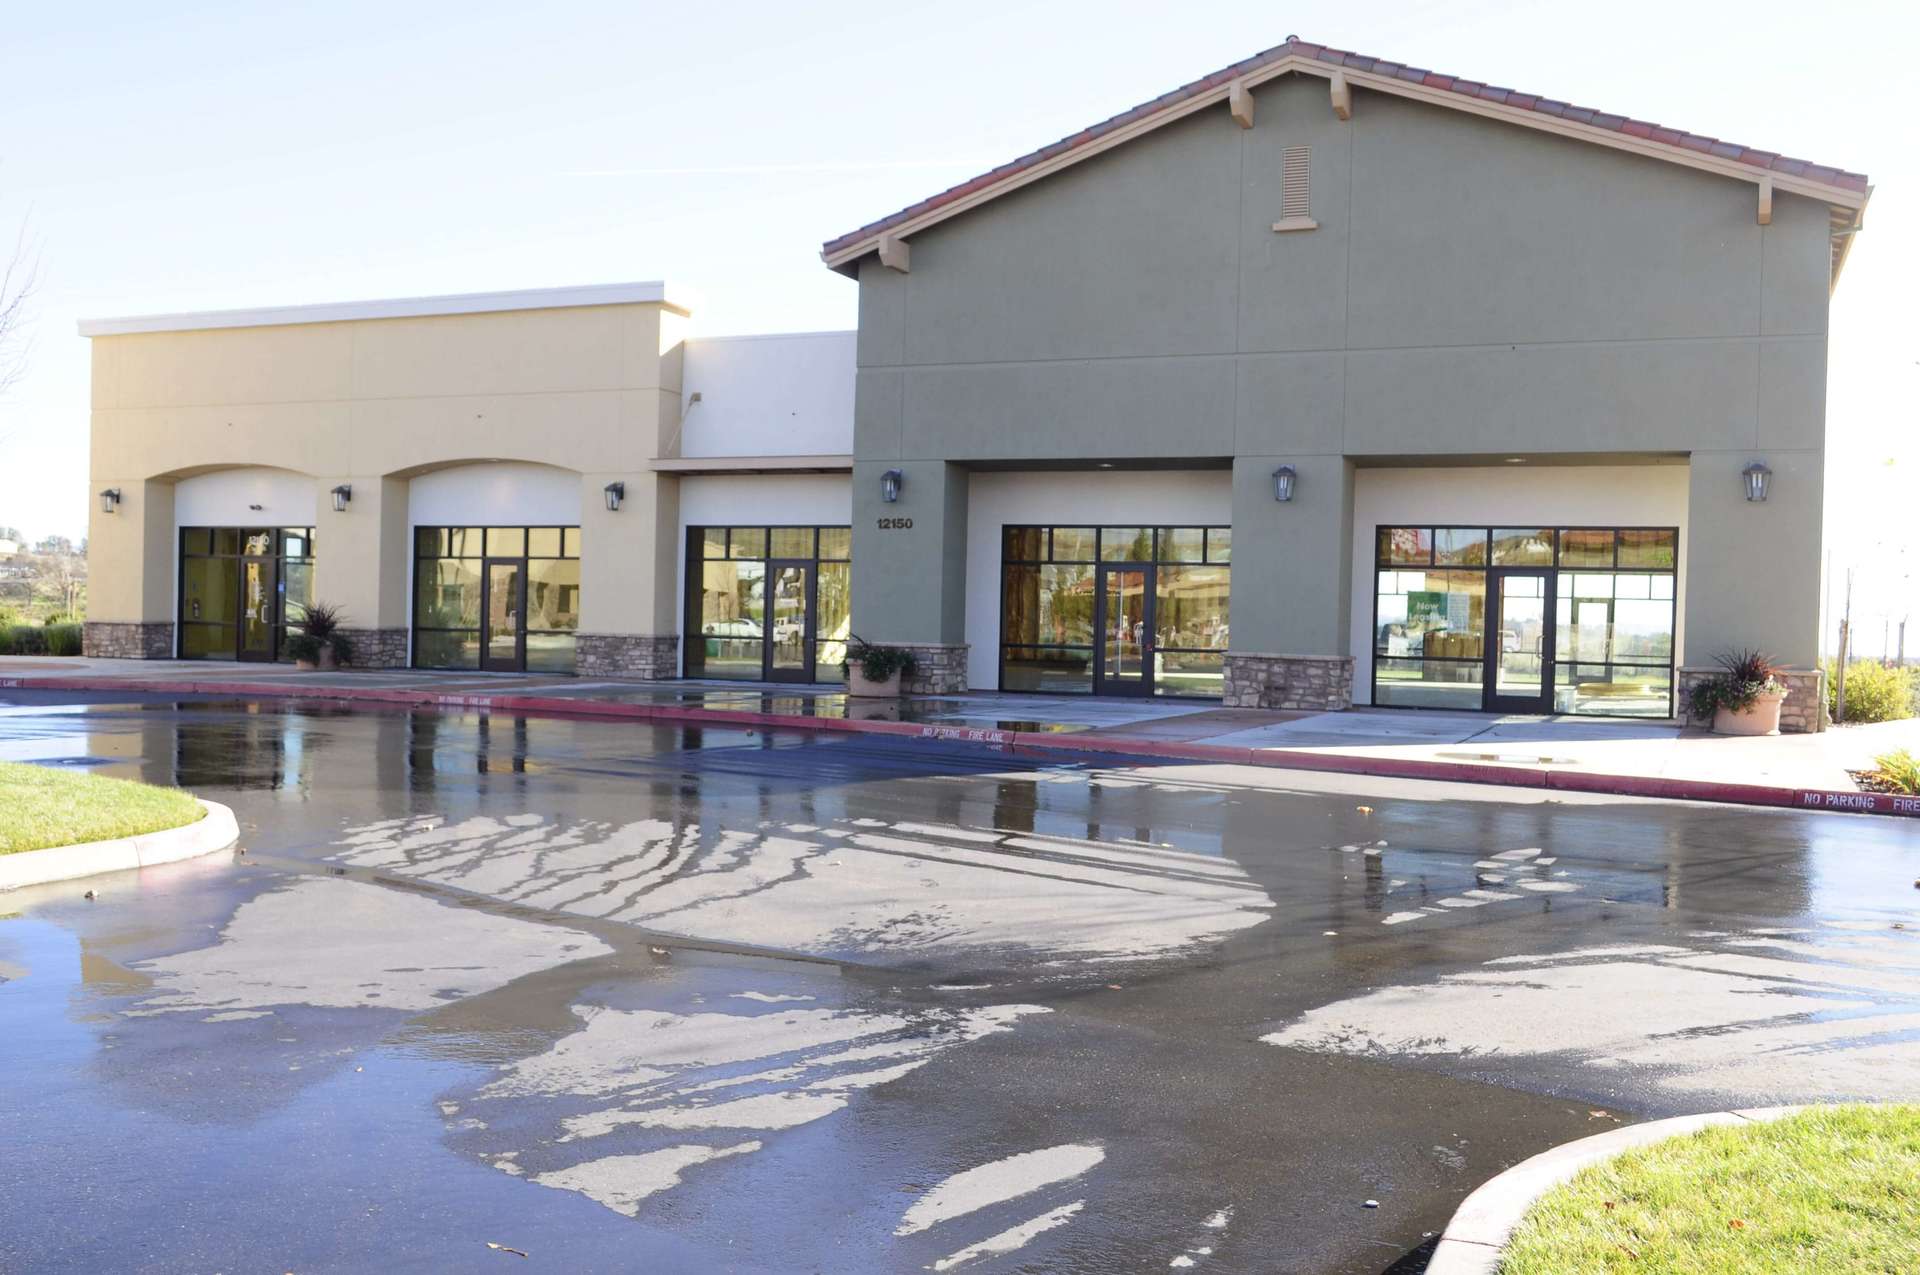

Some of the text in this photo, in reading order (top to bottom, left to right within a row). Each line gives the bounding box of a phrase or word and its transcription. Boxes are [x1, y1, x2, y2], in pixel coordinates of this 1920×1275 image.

[877, 518, 913, 529] 12150
[1416, 602, 1440, 610] Now
[1804, 793, 1821, 804] NO
[1825, 794, 1875, 808] PARKING
